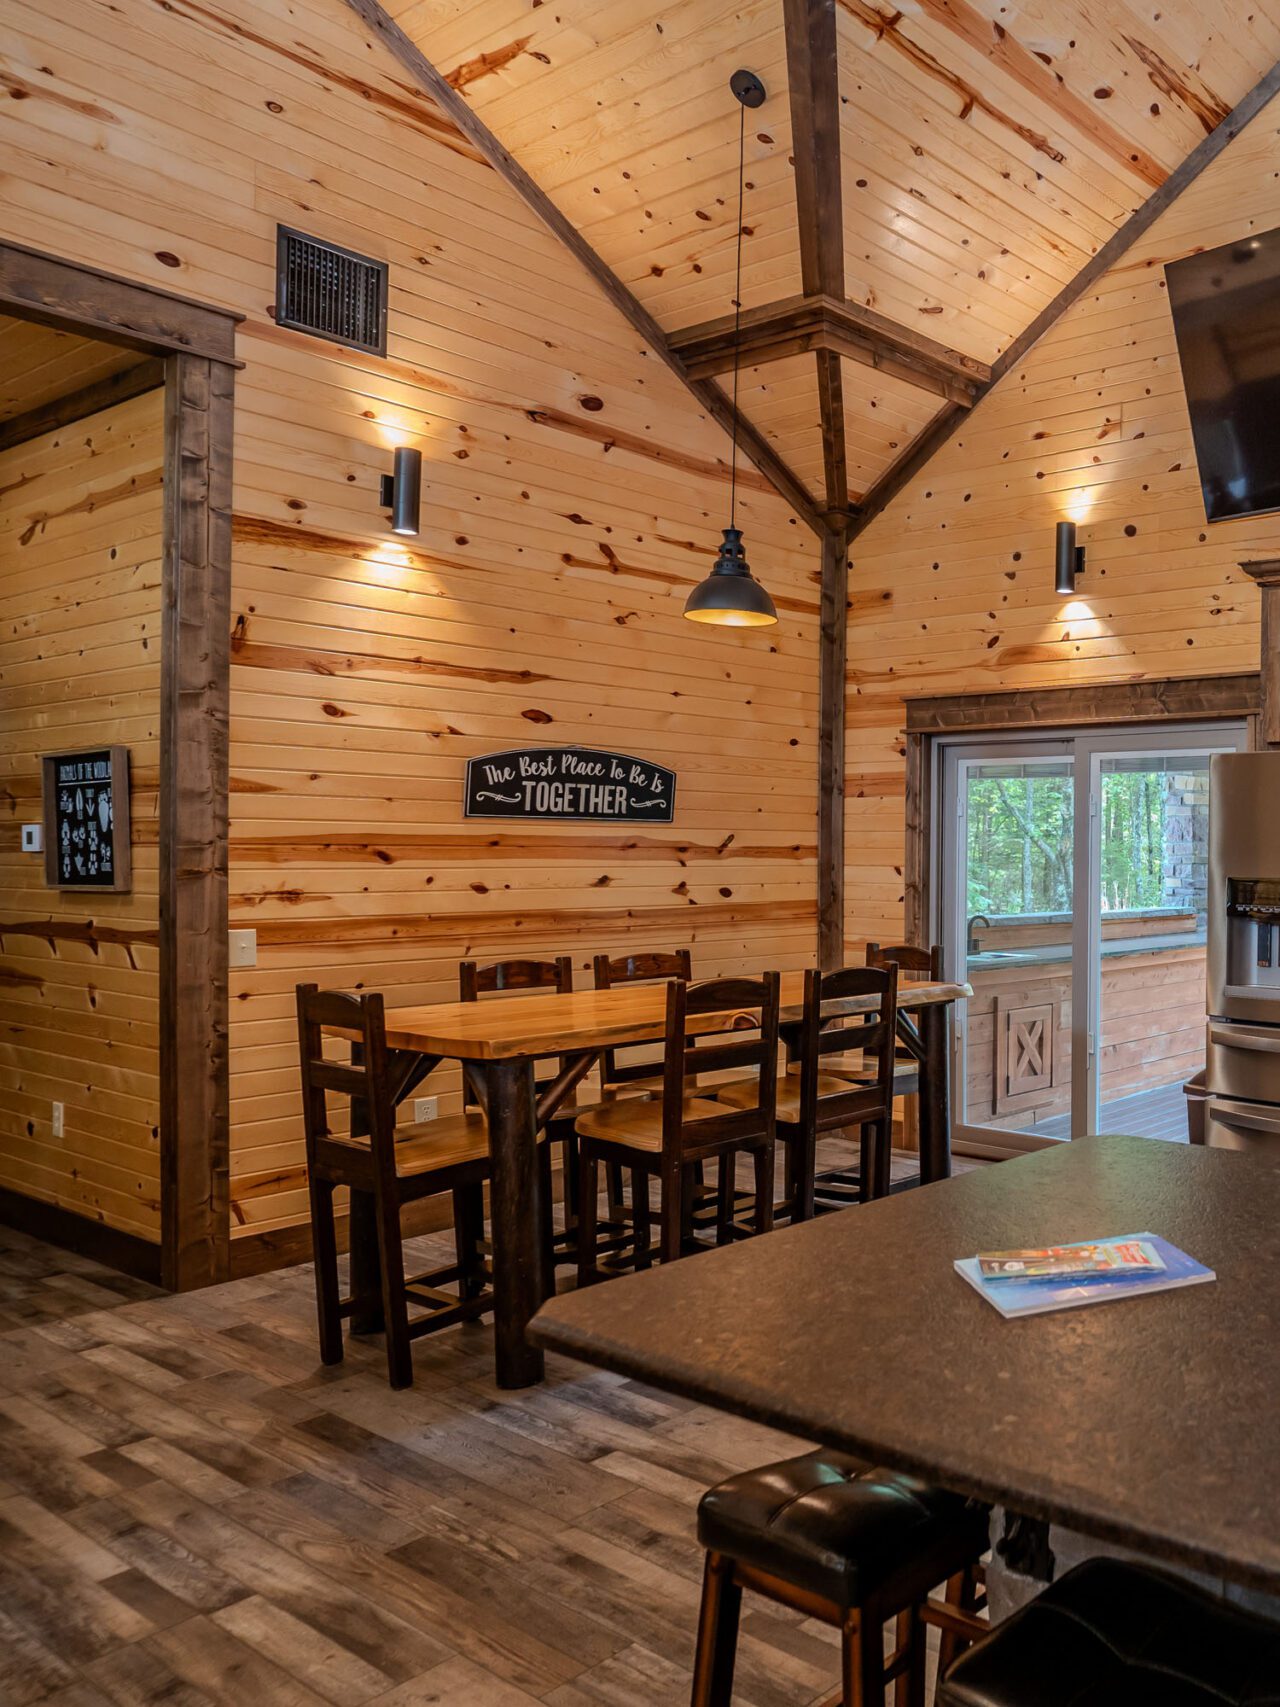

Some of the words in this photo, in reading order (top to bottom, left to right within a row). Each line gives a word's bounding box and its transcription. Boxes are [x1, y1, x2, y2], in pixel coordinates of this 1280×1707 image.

[482, 764, 516, 785] The
[519, 755, 557, 777] Best
[561, 754, 605, 777] Place
[610, 759, 626, 780] To
[629, 765, 648, 787] Be
[650, 772, 664, 793] Is
[522, 781, 627, 814] TOGETHER
